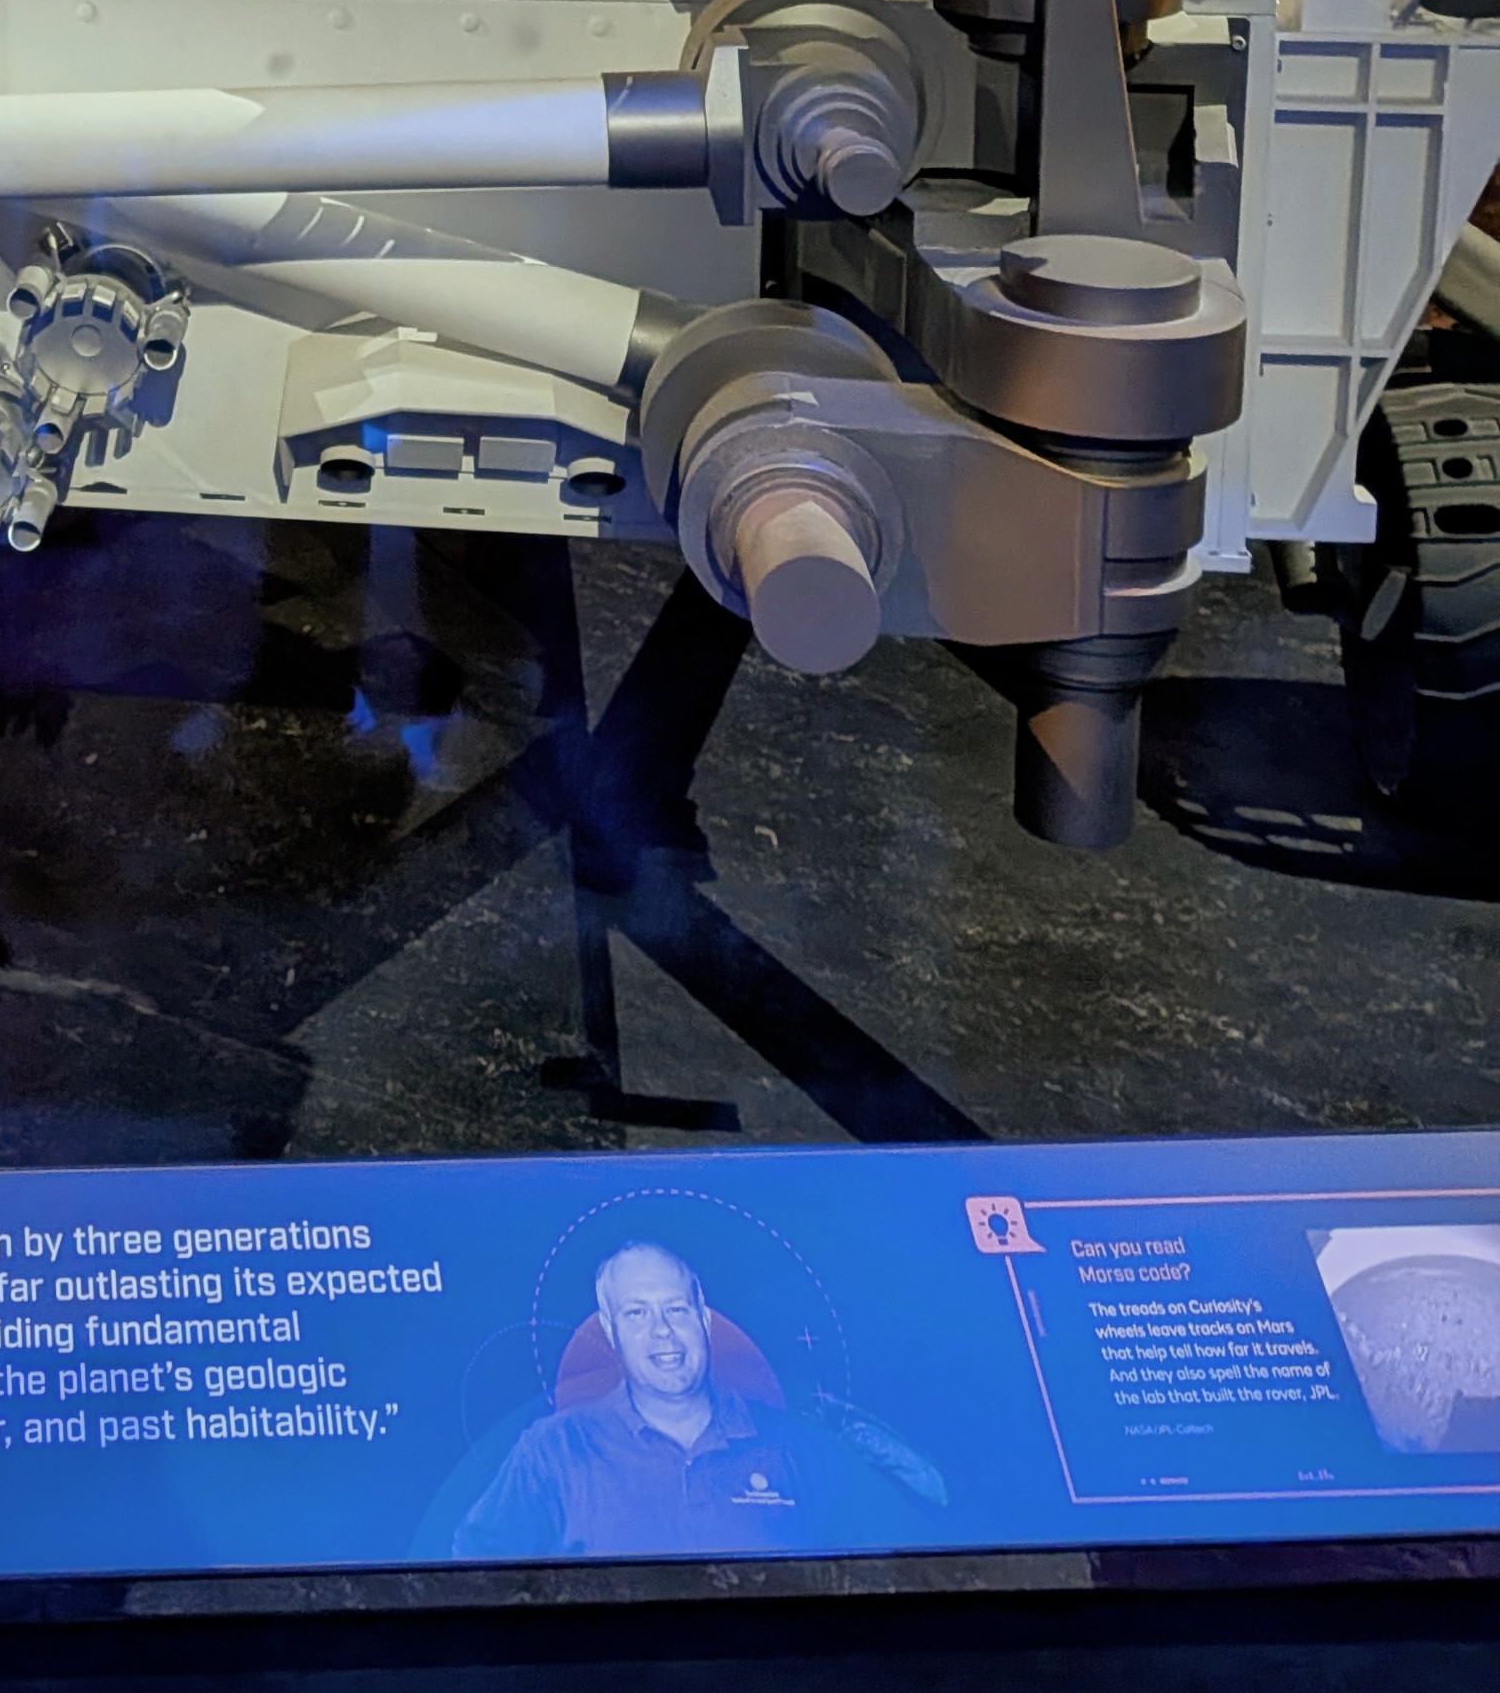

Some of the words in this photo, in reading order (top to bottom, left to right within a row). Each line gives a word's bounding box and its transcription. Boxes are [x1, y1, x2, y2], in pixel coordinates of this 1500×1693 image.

[24, 1226, 63, 1262] by
[73, 1225, 162, 1256] three
[173, 1219, 371, 1259] generations
[1070, 1238, 1107, 1258] Can
[1109, 1240, 1142, 1259] you
[1145, 1236, 1186, 1256] read
[55, 1267, 223, 1304] outlasting
[233, 1265, 276, 1298] its
[287, 1261, 443, 1301] expected
[1078, 1265, 1135, 1284] Morse
[1139, 1262, 1192, 1282] code?
[1088, 1301, 1116, 1317] The
[1118, 1300, 1165, 1317] treads
[1167, 1302, 1187, 1315] on
[85, 1310, 300, 1348] fundamental
[1095, 1323, 1146, 1339] wheels
[1149, 1322, 1186, 1338] leave
[1188, 1320, 1234, 1337] tracks
[1236, 1323, 1255, 1336] on
[1258, 1318, 1295, 1335] Mars
[1101, 1345, 1134, 1362] that
[1136, 1344, 1168, 1363] help
[1169, 1343, 1192, 1359] tell
[1194, 1342, 1226, 1359] how
[1228, 1341, 1249, 1358] far
[1251, 1340, 1264, 1356] it
[1266, 1339, 1319, 1356] travels.
[59, 1361, 193, 1401] planet’s
[204, 1357, 347, 1397] geologic
[1109, 1367, 1138, 1383] And
[1140, 1366, 1173, 1384] they
[1176, 1364, 1206, 1381] also
[1208, 1364, 1242, 1383] spell
[1243, 1362, 1269, 1379] the
[1271, 1366, 1313, 1379] name
[1315, 1360, 1331, 1377] of
[1114, 1389, 1140, 1406] the
[1143, 1388, 1166, 1405] lab
[1168, 1387, 1201, 1403] that
[1203, 1386, 1236, 1403] built
[1237, 1385, 1263, 1402] the
[1265, 1387, 1307, 1402] rover,
[24, 1410, 86, 1444] and
[100, 1409, 176, 1448] past
[186, 1403, 399, 1441] habitability.”
